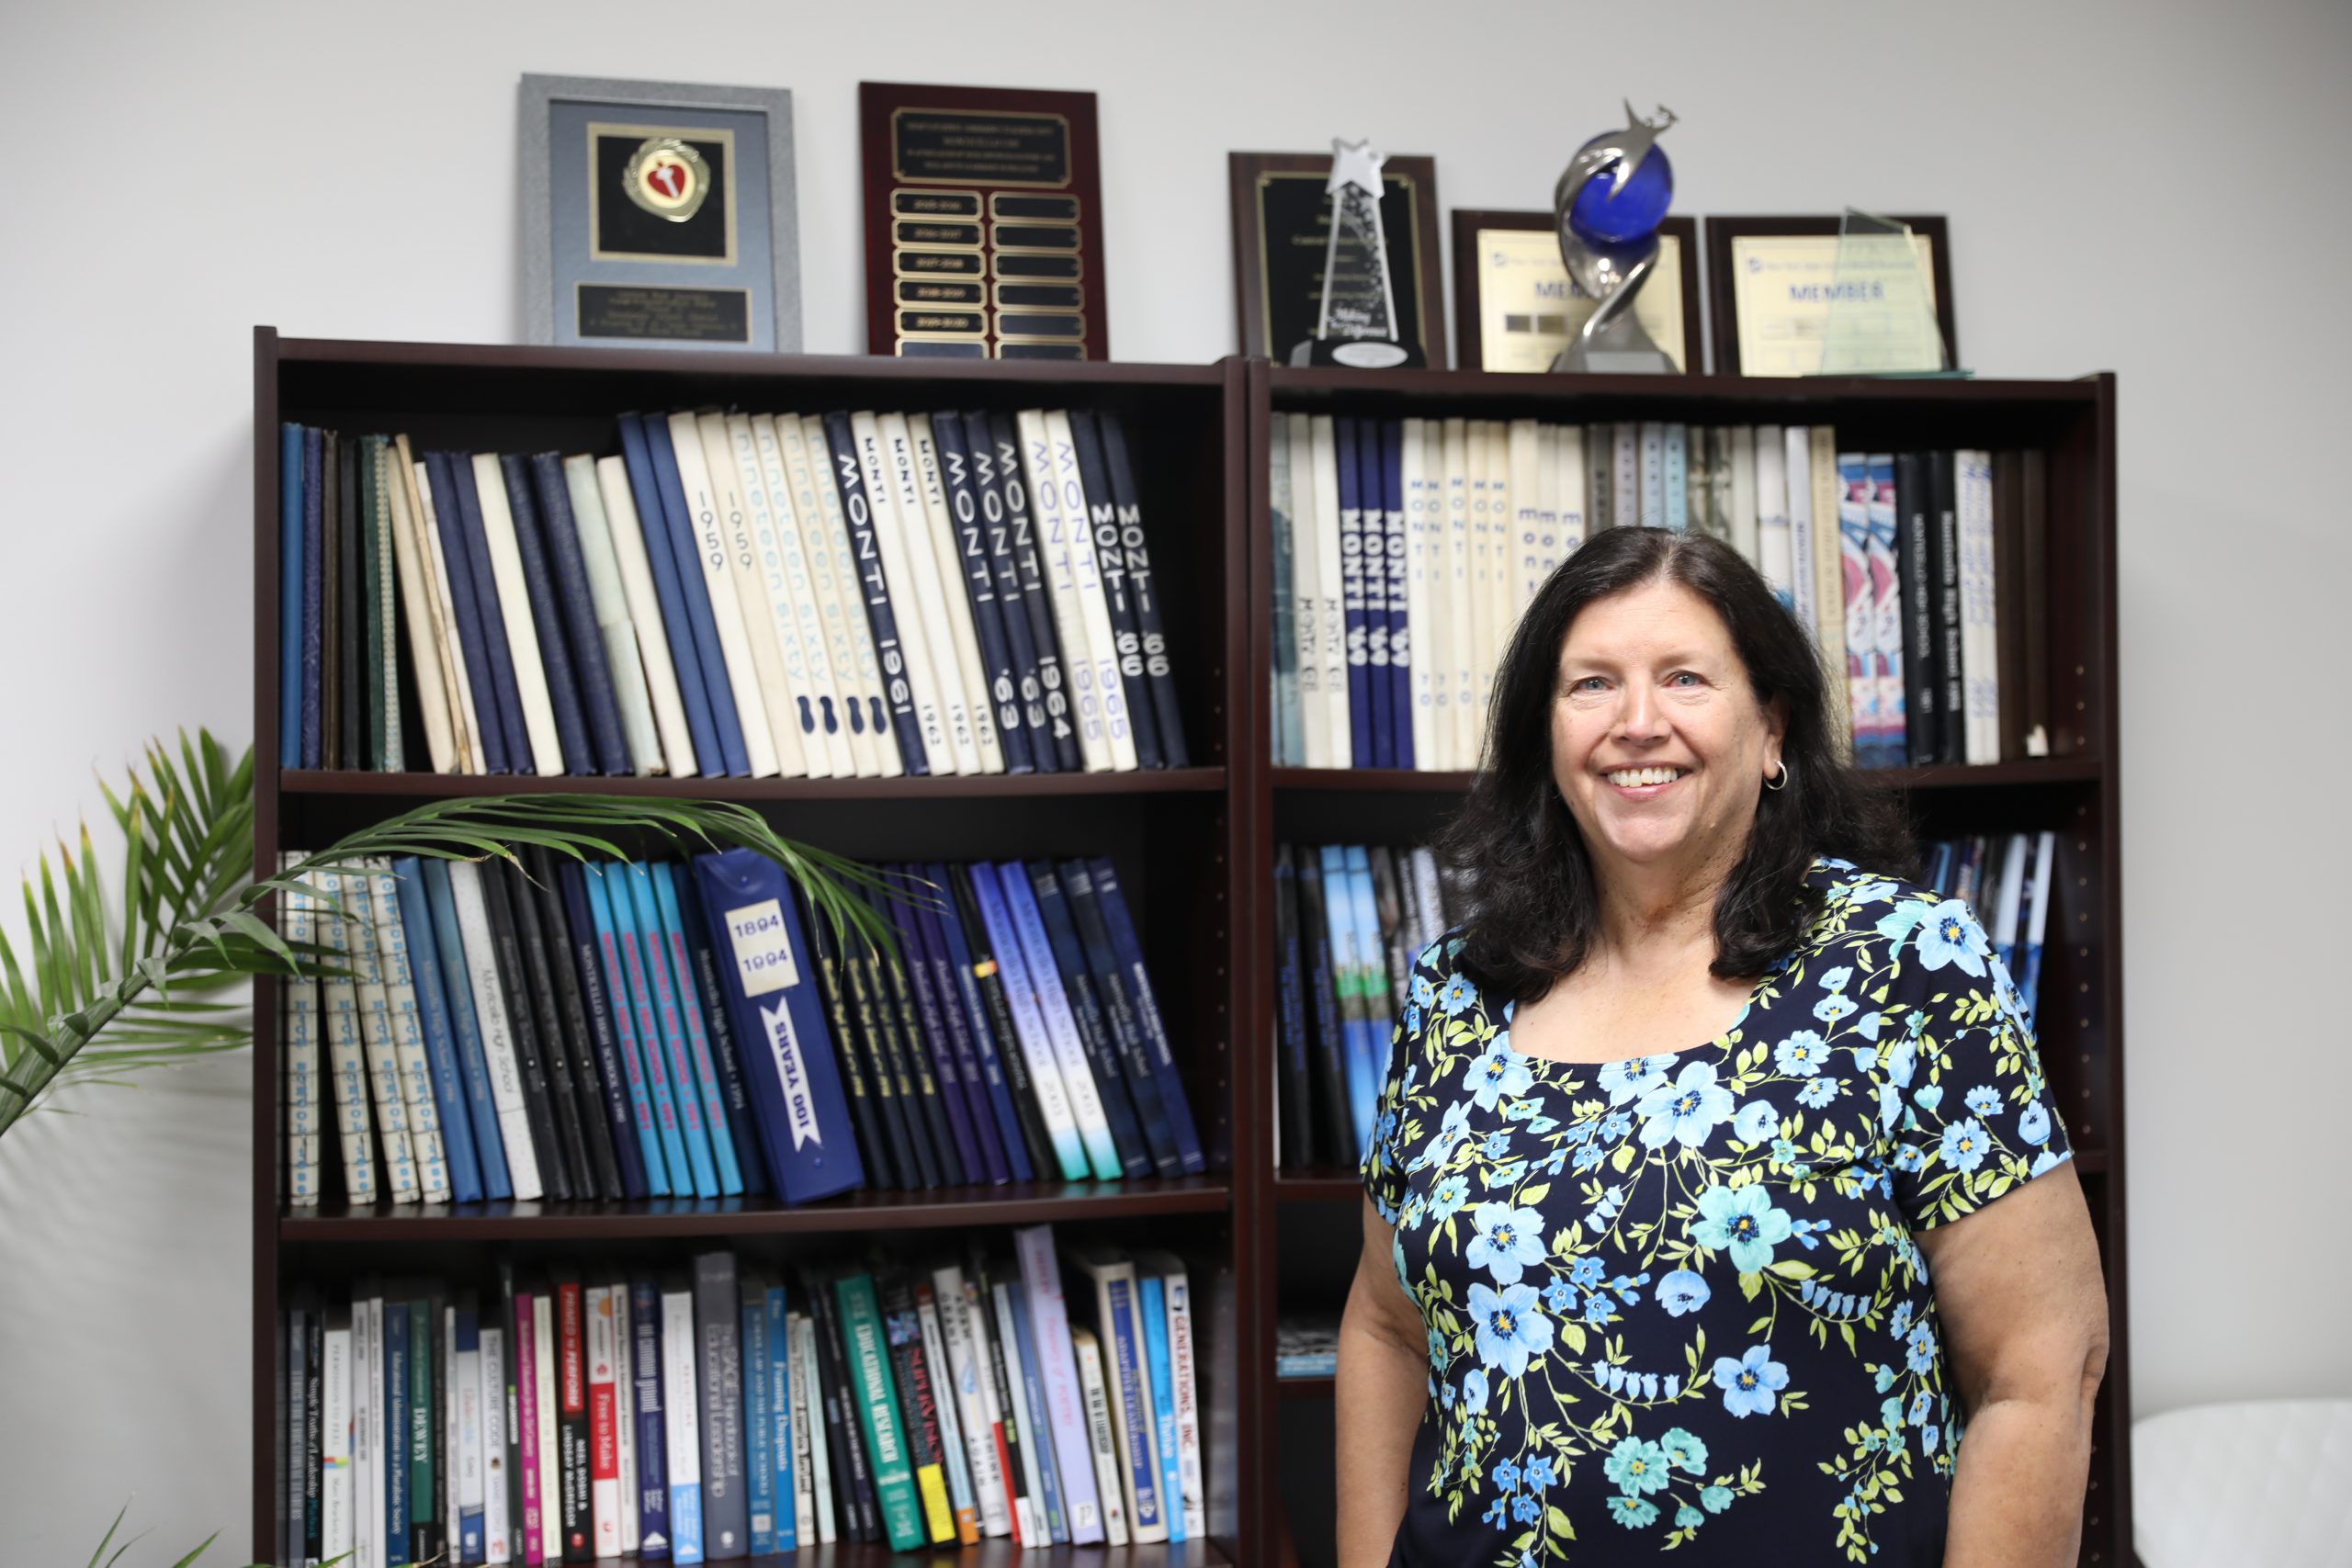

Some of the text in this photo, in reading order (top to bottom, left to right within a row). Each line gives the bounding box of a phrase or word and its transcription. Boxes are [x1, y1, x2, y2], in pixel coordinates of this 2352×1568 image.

[1791, 279, 1885, 303] MEMBER
[838, 453, 888, 606] MONTI
[945, 450, 994, 603] MONTI
[974, 451, 1022, 603] MONTI
[997, 440, 1043, 592] MONTI
[1032, 440, 1073, 591] MONTI
[1056, 440, 1098, 590] MONTI
[1091, 502, 1126, 612] MONTI
[1117, 502, 1151, 614] MONTI
[733, 913, 781, 939] 1894
[741, 948, 789, 974] 1994
[775, 1021, 811, 1130] 100 YEARS
[635, 1379, 662, 1412] ground
[639, 1339, 657, 1377] common
[1172, 1314, 1194, 1456] GENERATIONS, INC.
[413, 1406, 426, 1463] DEWEY
[596, 1392, 616, 1470] Free to Make
